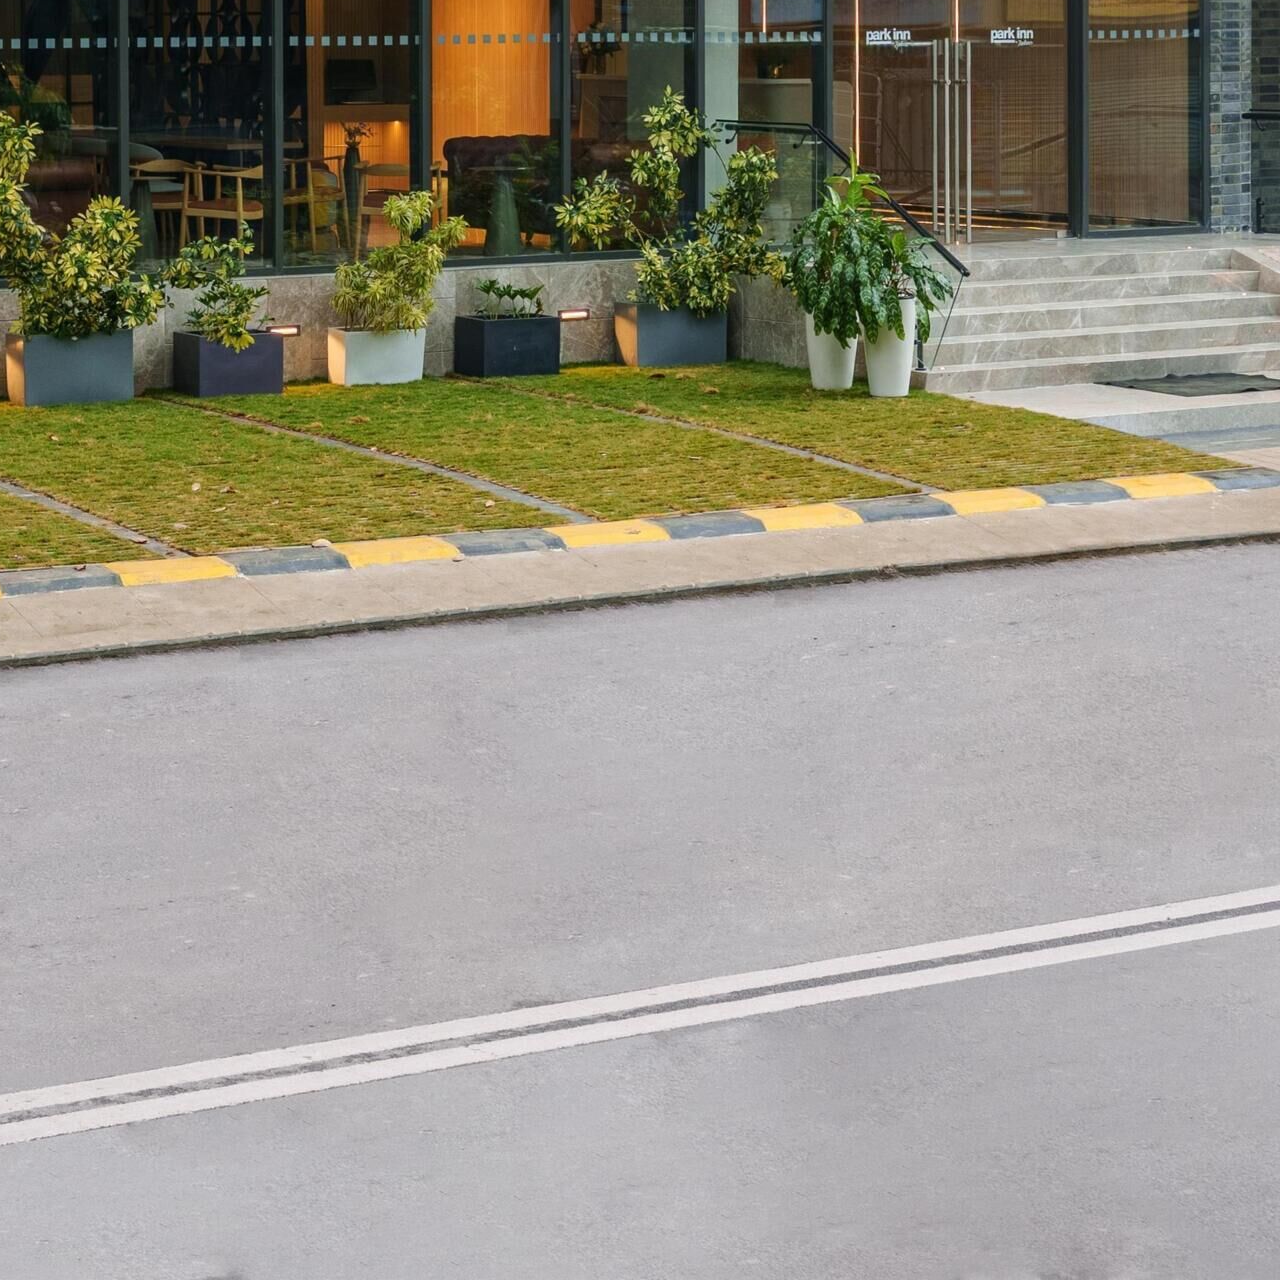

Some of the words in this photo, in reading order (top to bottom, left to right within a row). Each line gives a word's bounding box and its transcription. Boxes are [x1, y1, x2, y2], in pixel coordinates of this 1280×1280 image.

[866, 28, 892, 45] park
[892, 28, 911, 41] inn
[990, 27, 1016, 44] park
[1016, 27, 1034, 39] inn
